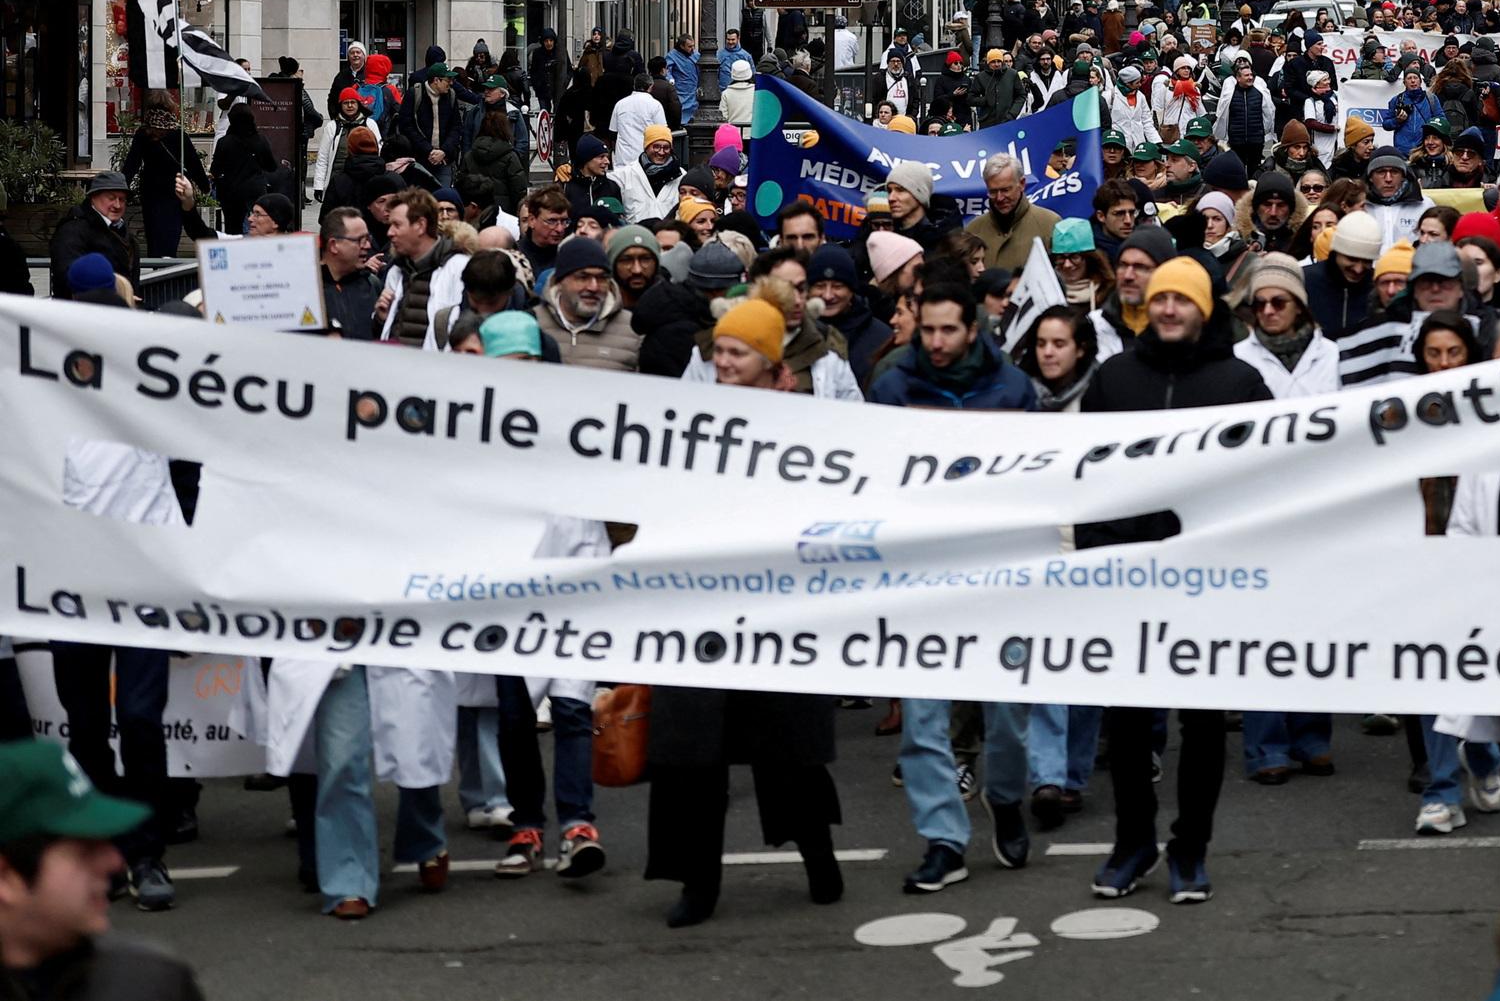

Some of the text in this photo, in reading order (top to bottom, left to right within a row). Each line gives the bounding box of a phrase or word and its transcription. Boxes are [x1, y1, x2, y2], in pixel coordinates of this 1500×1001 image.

[800, 158, 878, 194] MÉDE
[866, 147, 942, 182] AVC
[797, 194, 867, 226] PATIE
[18, 325, 102, 390] La
[136, 346, 314, 420] Sécu
[347, 386, 539, 450] parle
[569, 402, 873, 496] chiffres,
[900, 446, 1063, 488] nous
[1074, 404, 1338, 480] parlons
[404, 557, 1269, 602] Fédération Nationale des Médecins Radiologues
[16, 565, 86, 621] La
[110, 594, 421, 652] radiologie
[440, 611, 611, 662] coûte
[634, 616, 819, 667] moins
[841, 618, 977, 670] cher
[999, 634, 1114, 685] que
[1137, 620, 1369, 679] l'erreur
